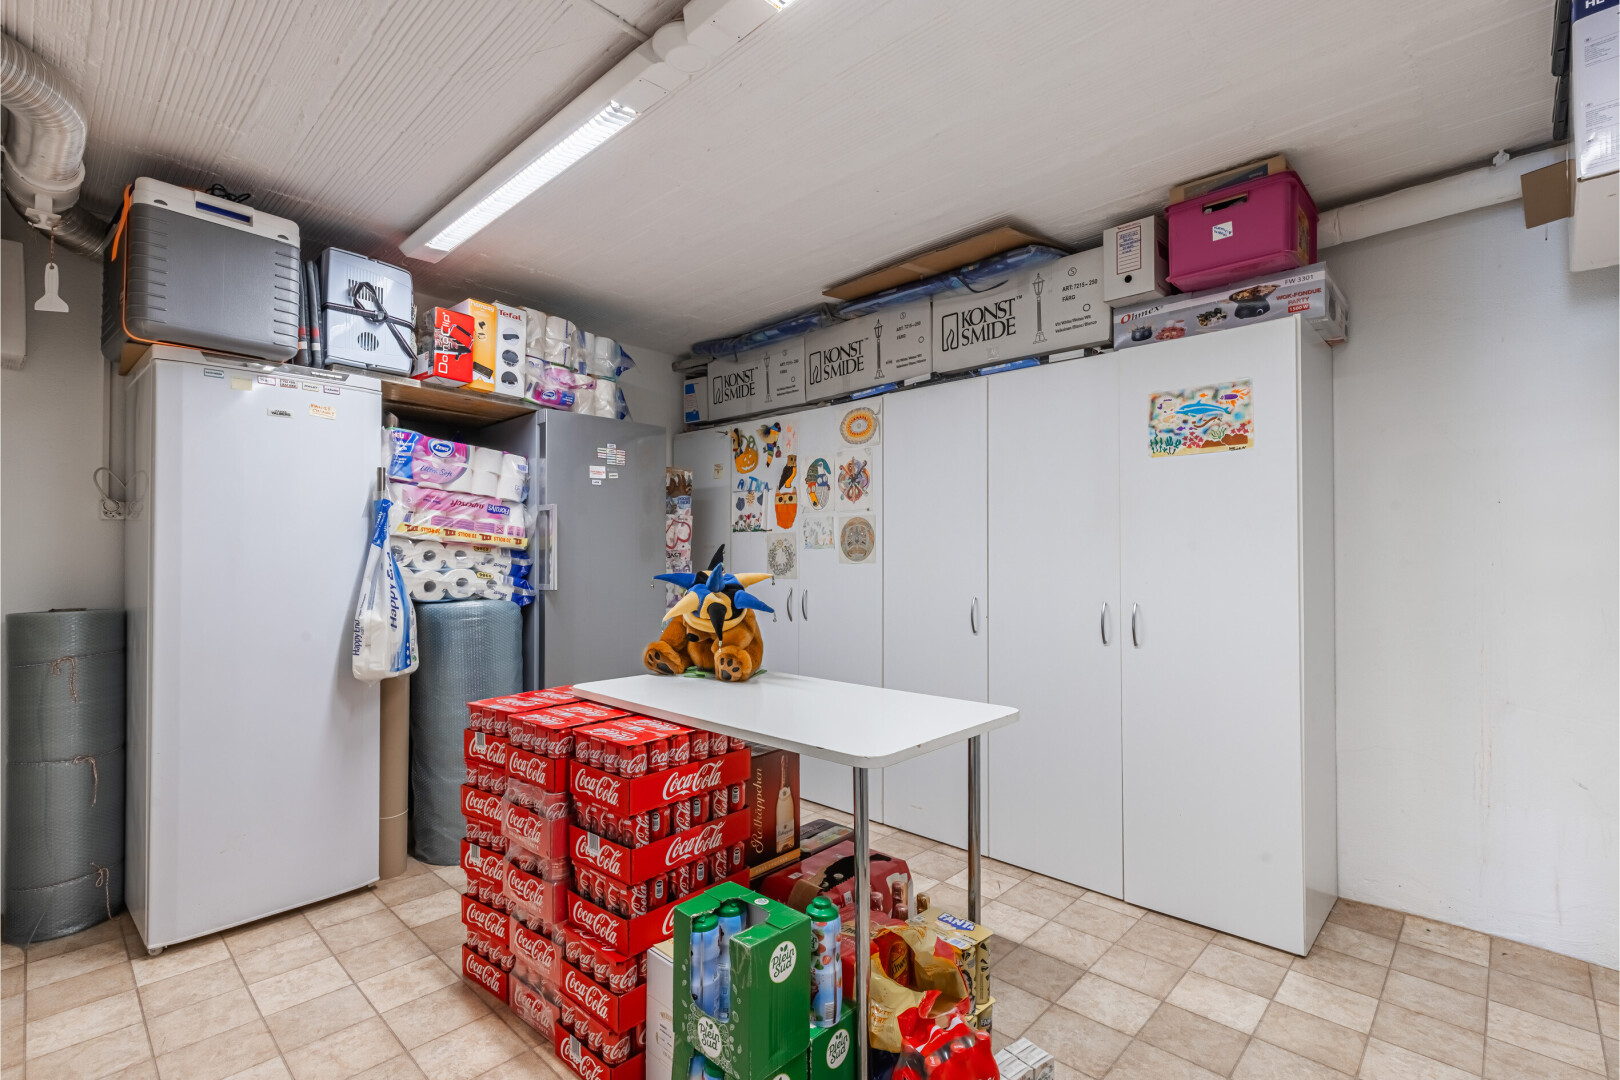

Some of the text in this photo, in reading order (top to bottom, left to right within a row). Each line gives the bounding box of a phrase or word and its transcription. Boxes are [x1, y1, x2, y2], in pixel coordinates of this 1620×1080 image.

[1285, 274, 1314, 285] FW 3301
[1276, 287, 1322, 301] WOK-FONDUE
[1288, 296, 1310, 305] PARTY
[498, 308, 523, 321] Tefal
[961, 297, 1016, 329] KONST
[961, 316, 1017, 347] SMIDE
[823, 338, 864, 365] KONST
[724, 368, 755, 388] KONST
[823, 355, 865, 382] SMIDE
[724, 382, 756, 402] SMIDE
[388, 584, 400, 629] Happy
[352, 633, 362, 656] Happy
[509, 751, 548, 785] Coca-Cola
[662, 759, 725, 801] Coca-Cola
[575, 768, 621, 806] Coca-Cola
[751, 768, 766, 854] Rotkäppchen
[665, 820, 726, 867] Coca-Cola
[466, 902, 507, 938] Coca-Cola
[573, 900, 620, 945] Coca-Cola
[937, 912, 976, 931] FANTA
[771, 946, 797, 969] Plein
[773, 958, 793, 979] Sud
[466, 953, 501, 993] Coca-Cola
[565, 970, 611, 1019] Coca-Cola
[699, 1022, 720, 1043] Plein
[701, 1033, 719, 1051] Sud
[828, 1034, 849, 1057] Plein
[831, 1047, 847, 1065] Sud
